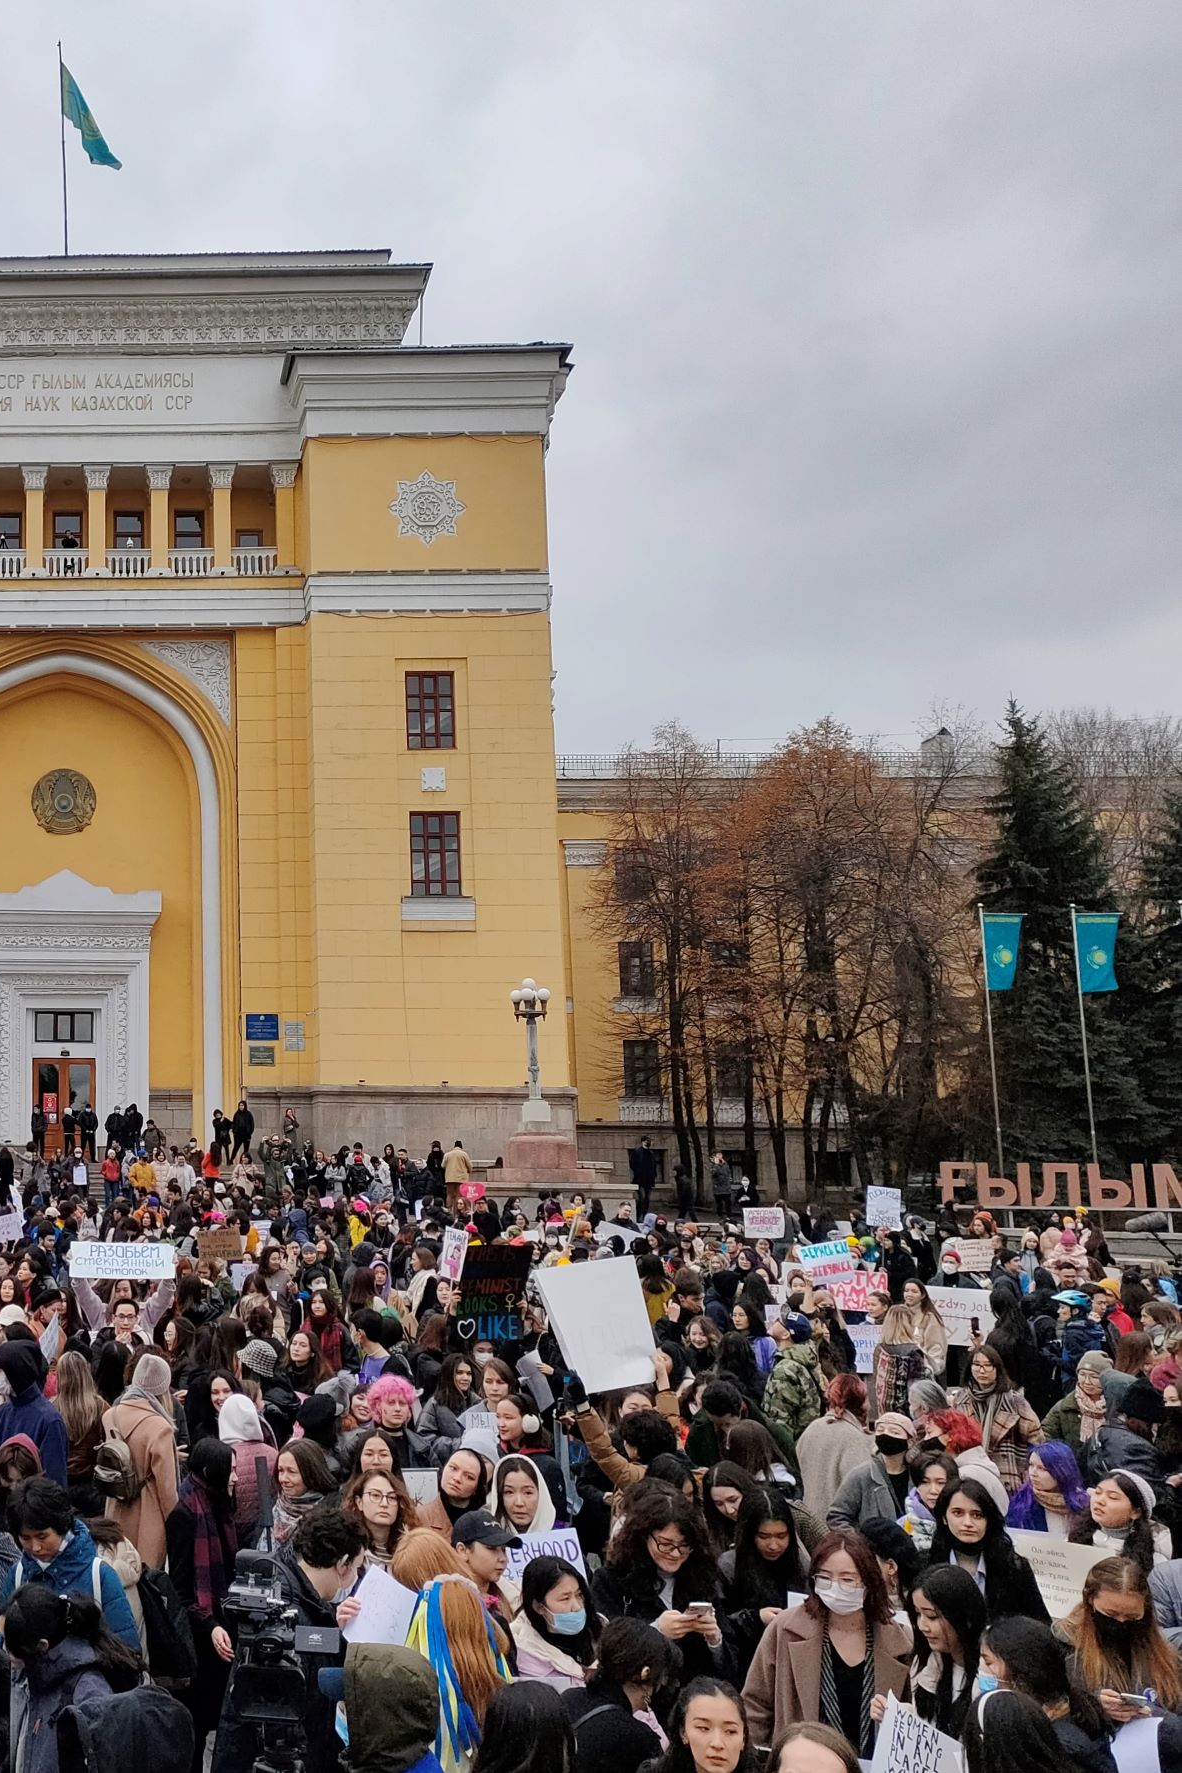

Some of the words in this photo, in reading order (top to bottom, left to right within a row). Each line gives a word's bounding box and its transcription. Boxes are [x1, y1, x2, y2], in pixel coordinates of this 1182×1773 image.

[32, 373, 86, 390] ҒЫЛЫМ
[95, 372, 194, 390] АКАДЕМИЯСЫ
[25, 396, 60, 411] НАУК
[71, 394, 152, 411] КАЗАХСКОЙ
[165, 396, 193, 411] ССР
[477, 1315, 518, 1341] LIKE
[471, 1414, 490, 1428] МЫ
[510, 1538, 579, 1564] ERHOOD
[897, 1704, 940, 1746] WOMEN
